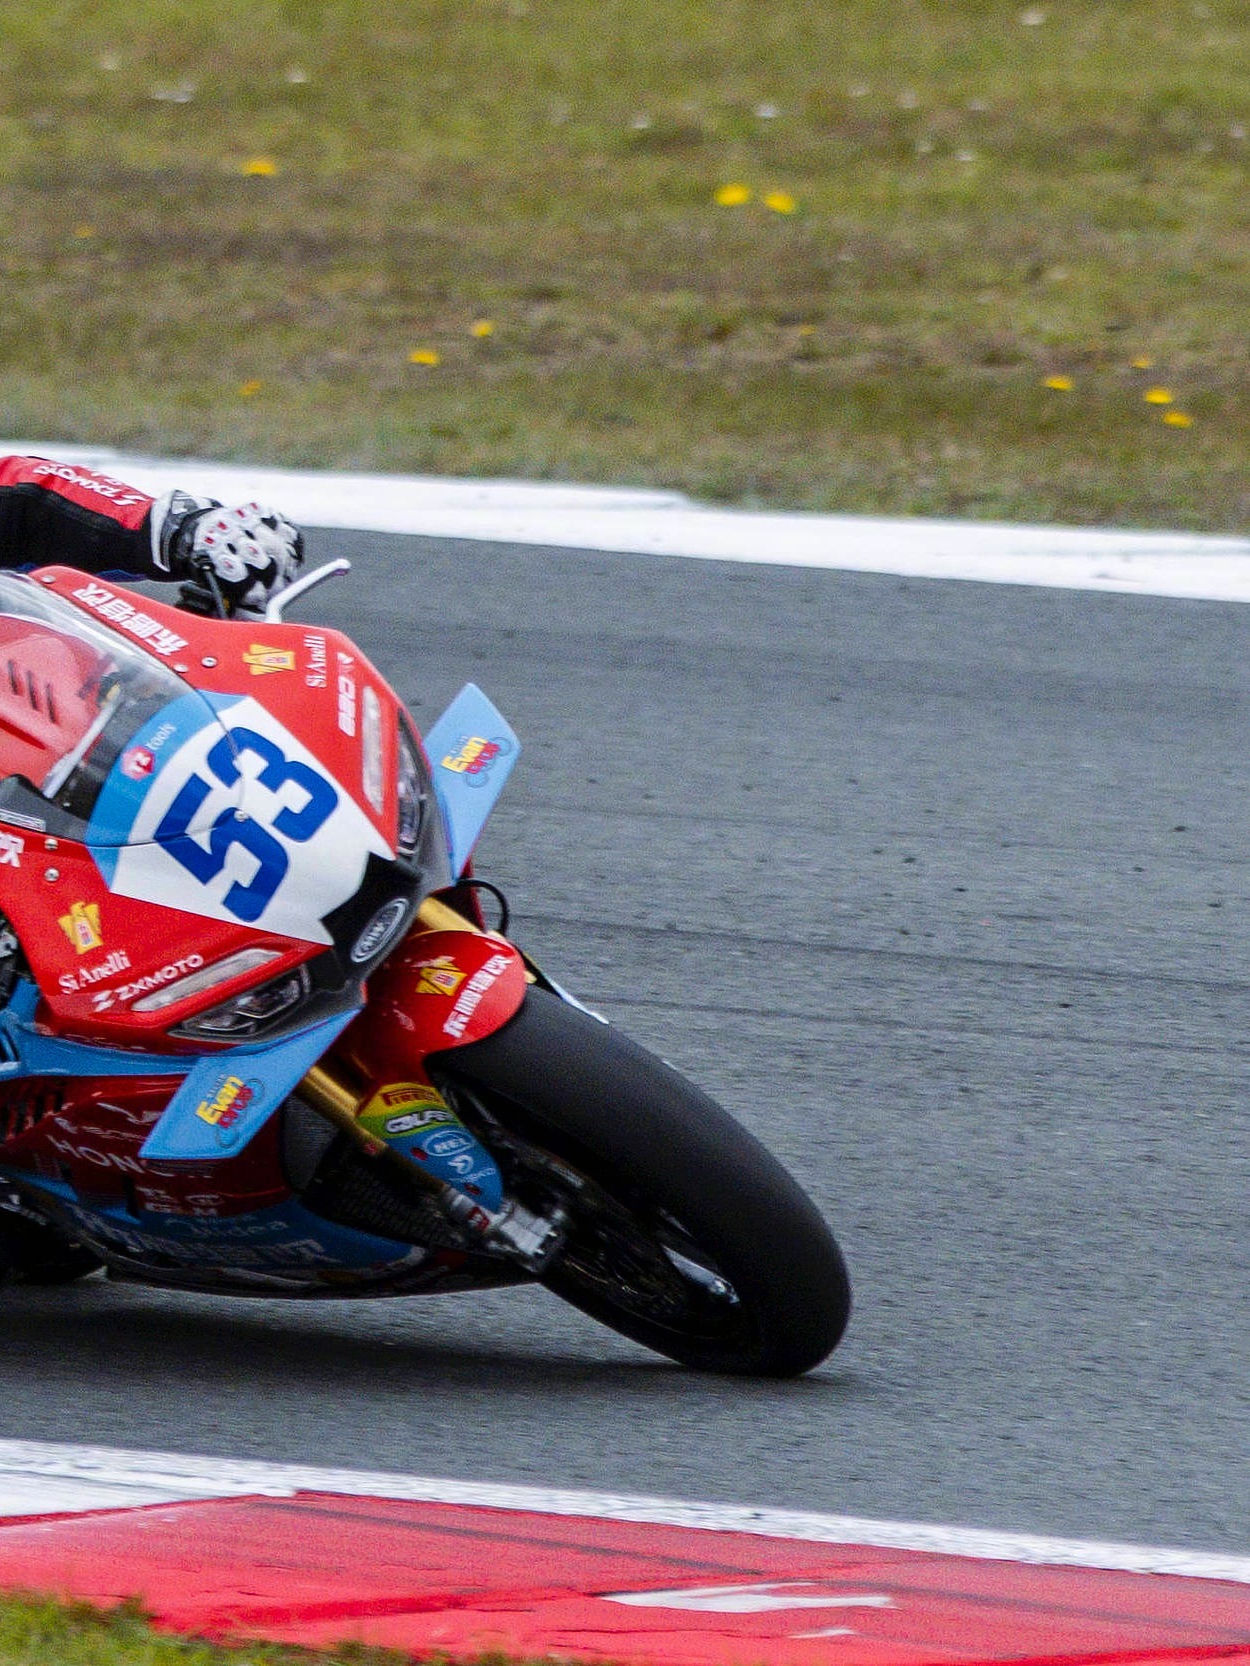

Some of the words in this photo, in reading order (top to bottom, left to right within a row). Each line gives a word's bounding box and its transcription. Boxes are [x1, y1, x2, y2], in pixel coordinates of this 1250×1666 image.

[440, 736, 489, 774] Evan
[153, 726, 339, 923] 53
[114, 953, 205, 999] ZXMOTO
[195, 1075, 245, 1127] Evan
